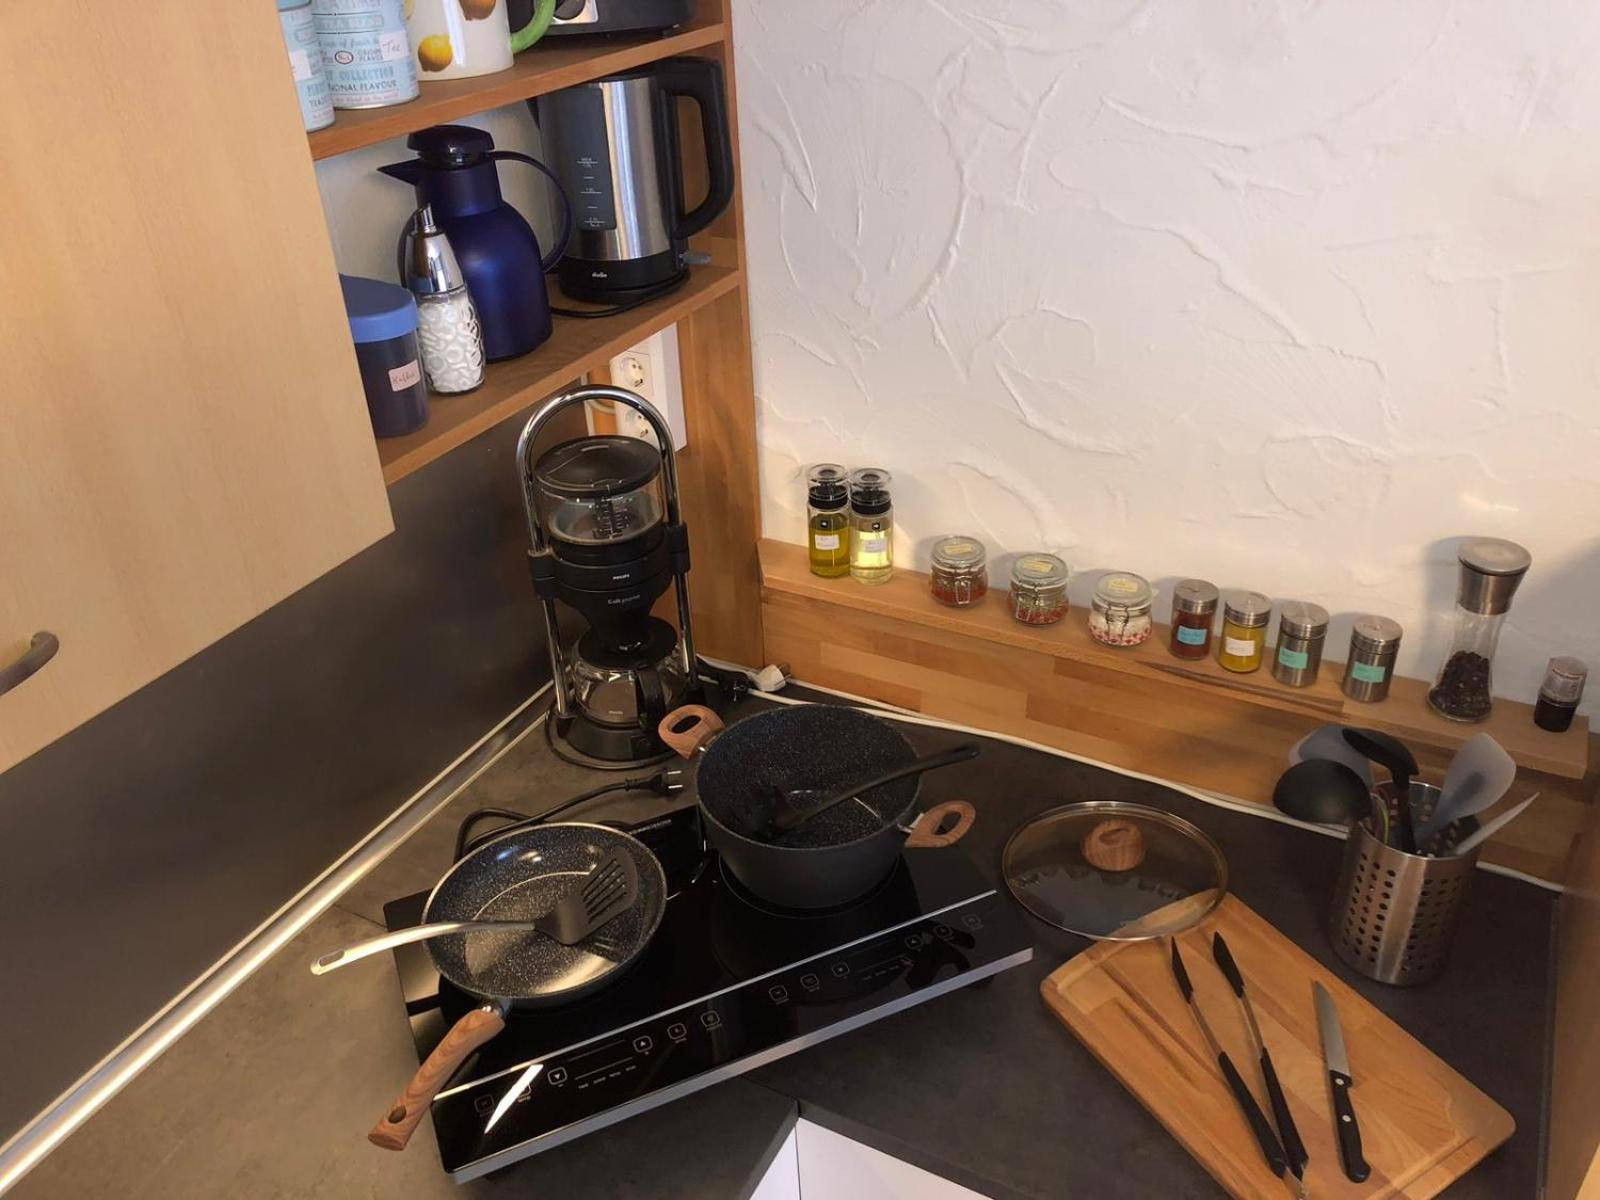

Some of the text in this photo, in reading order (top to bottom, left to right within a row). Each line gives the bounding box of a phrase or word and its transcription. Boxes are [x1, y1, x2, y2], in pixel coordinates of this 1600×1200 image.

[382, 40, 400, 53] Tee
[339, 66, 393, 81] COLLECTION
[360, 80, 397, 91] FLAVOUR
